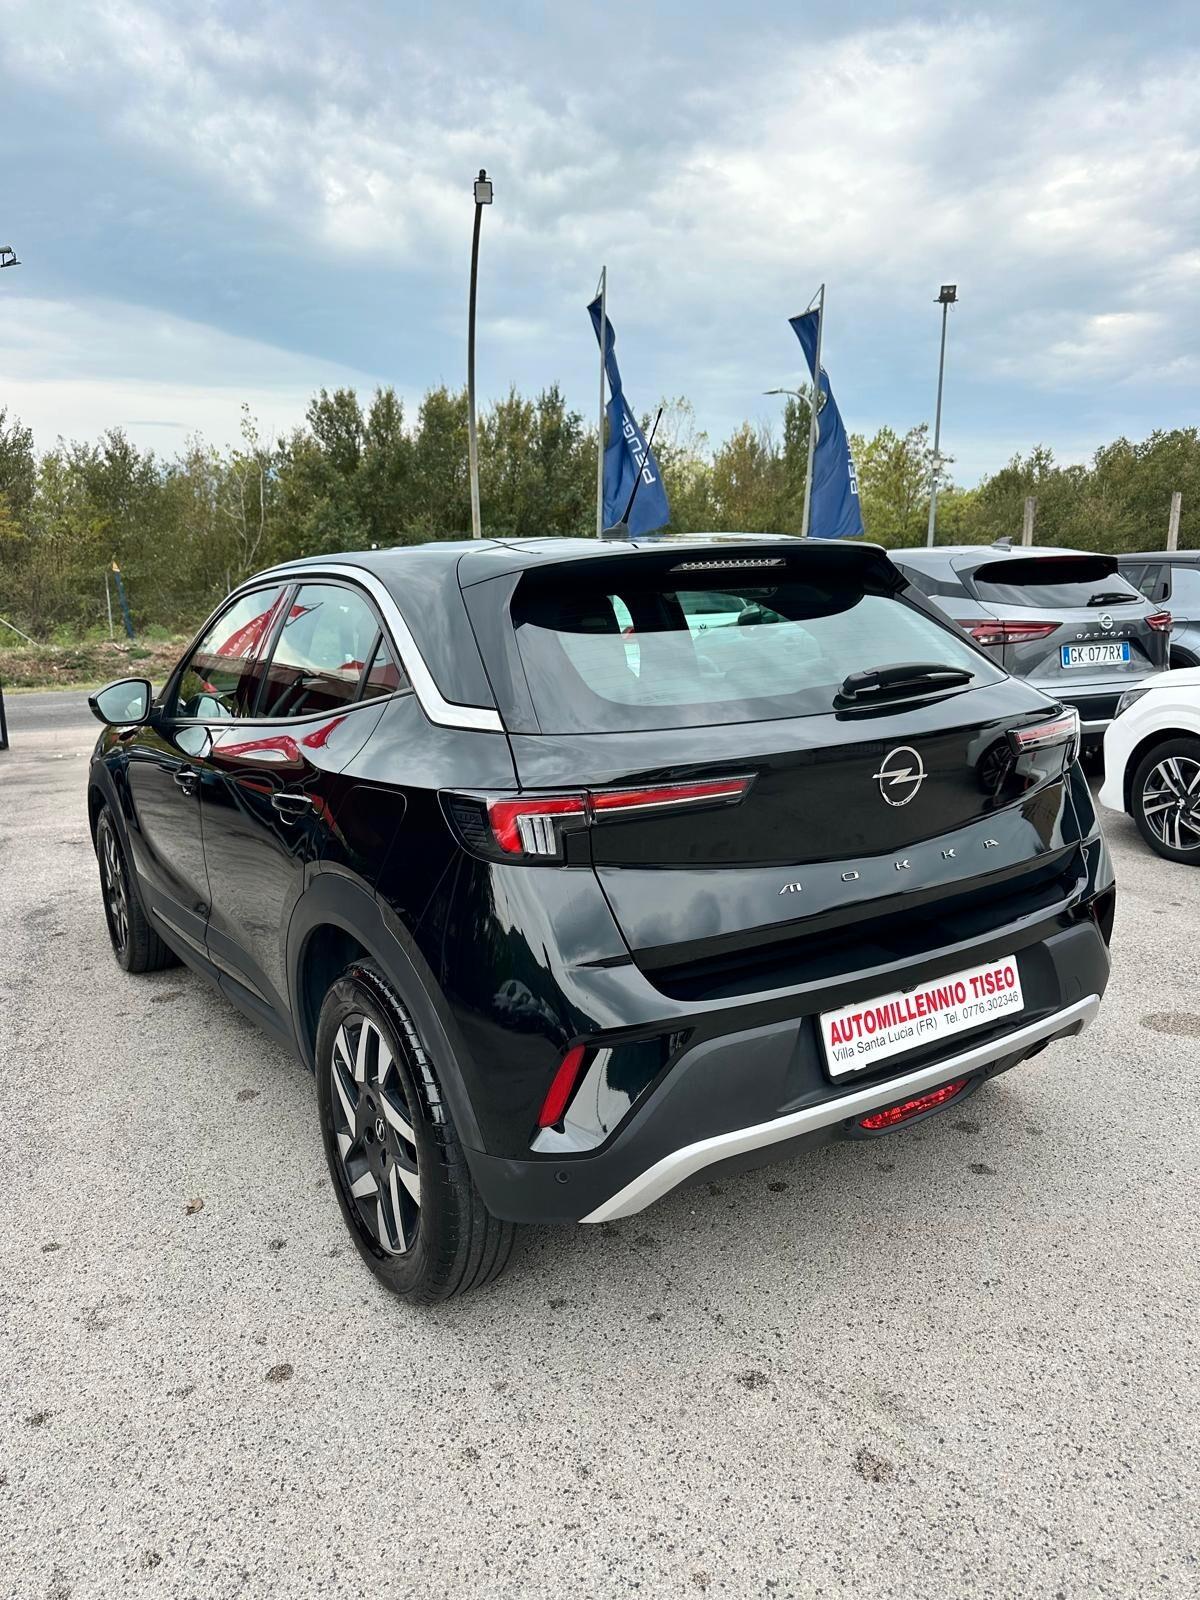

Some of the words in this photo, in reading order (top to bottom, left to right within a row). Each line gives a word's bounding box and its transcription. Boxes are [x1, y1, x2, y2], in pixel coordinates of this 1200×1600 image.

[1070, 647, 1084, 662] GK
[1088, 645, 1122, 661] 077RX
[778, 839, 1000, 895] MOKKA
[831, 981, 967, 1046] AUTOMILLENNIO
[969, 966, 1015, 999] TISEO
[832, 1046, 855, 1062] Villa
[857, 1034, 886, 1054] Santa
[888, 1025, 914, 1044] Lucia
[916, 1017, 938, 1036] (FR)
[944, 1012, 961, 1025] Tel.
[962, 991, 1019, 1019] 0776.302346
